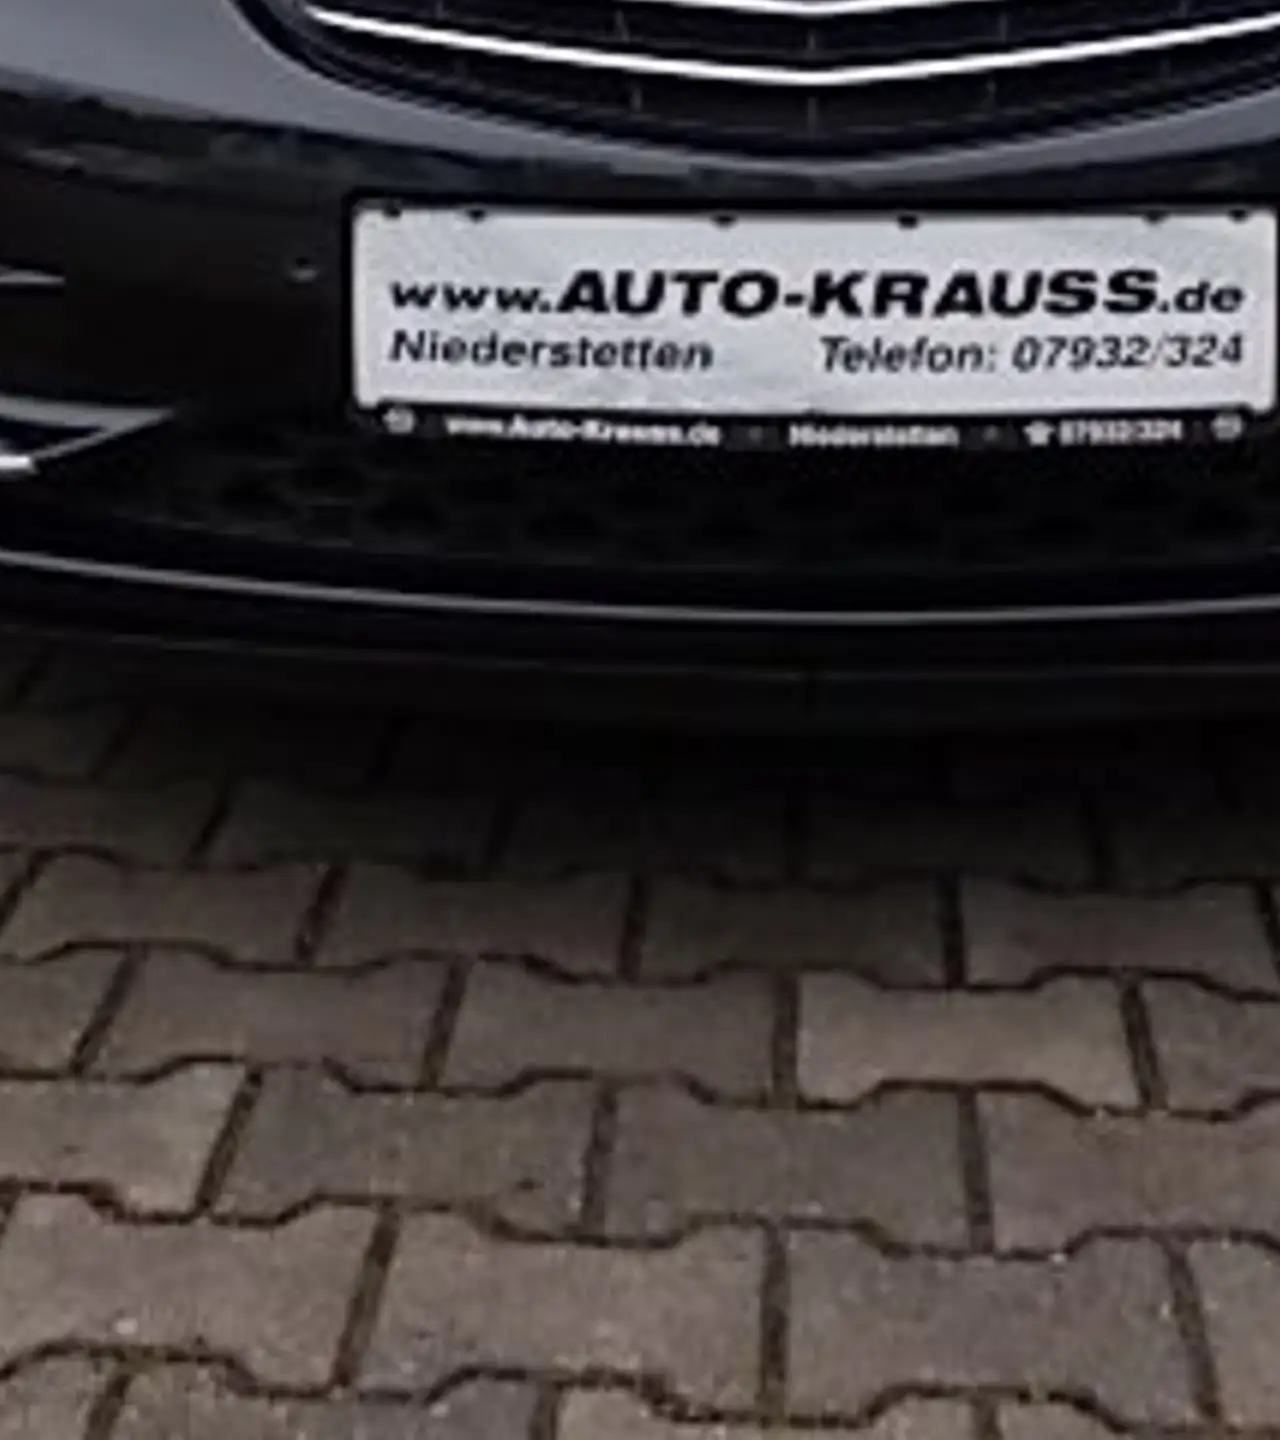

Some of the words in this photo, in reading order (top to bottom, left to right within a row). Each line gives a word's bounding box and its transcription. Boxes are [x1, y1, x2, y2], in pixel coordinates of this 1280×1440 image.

[391, 269, 1245, 317] www.AUTO-KRAUSS.de
[390, 329, 715, 371] Niederstetten
[821, 336, 997, 372] Telefon:
[1012, 332, 1244, 371] 07932/324
